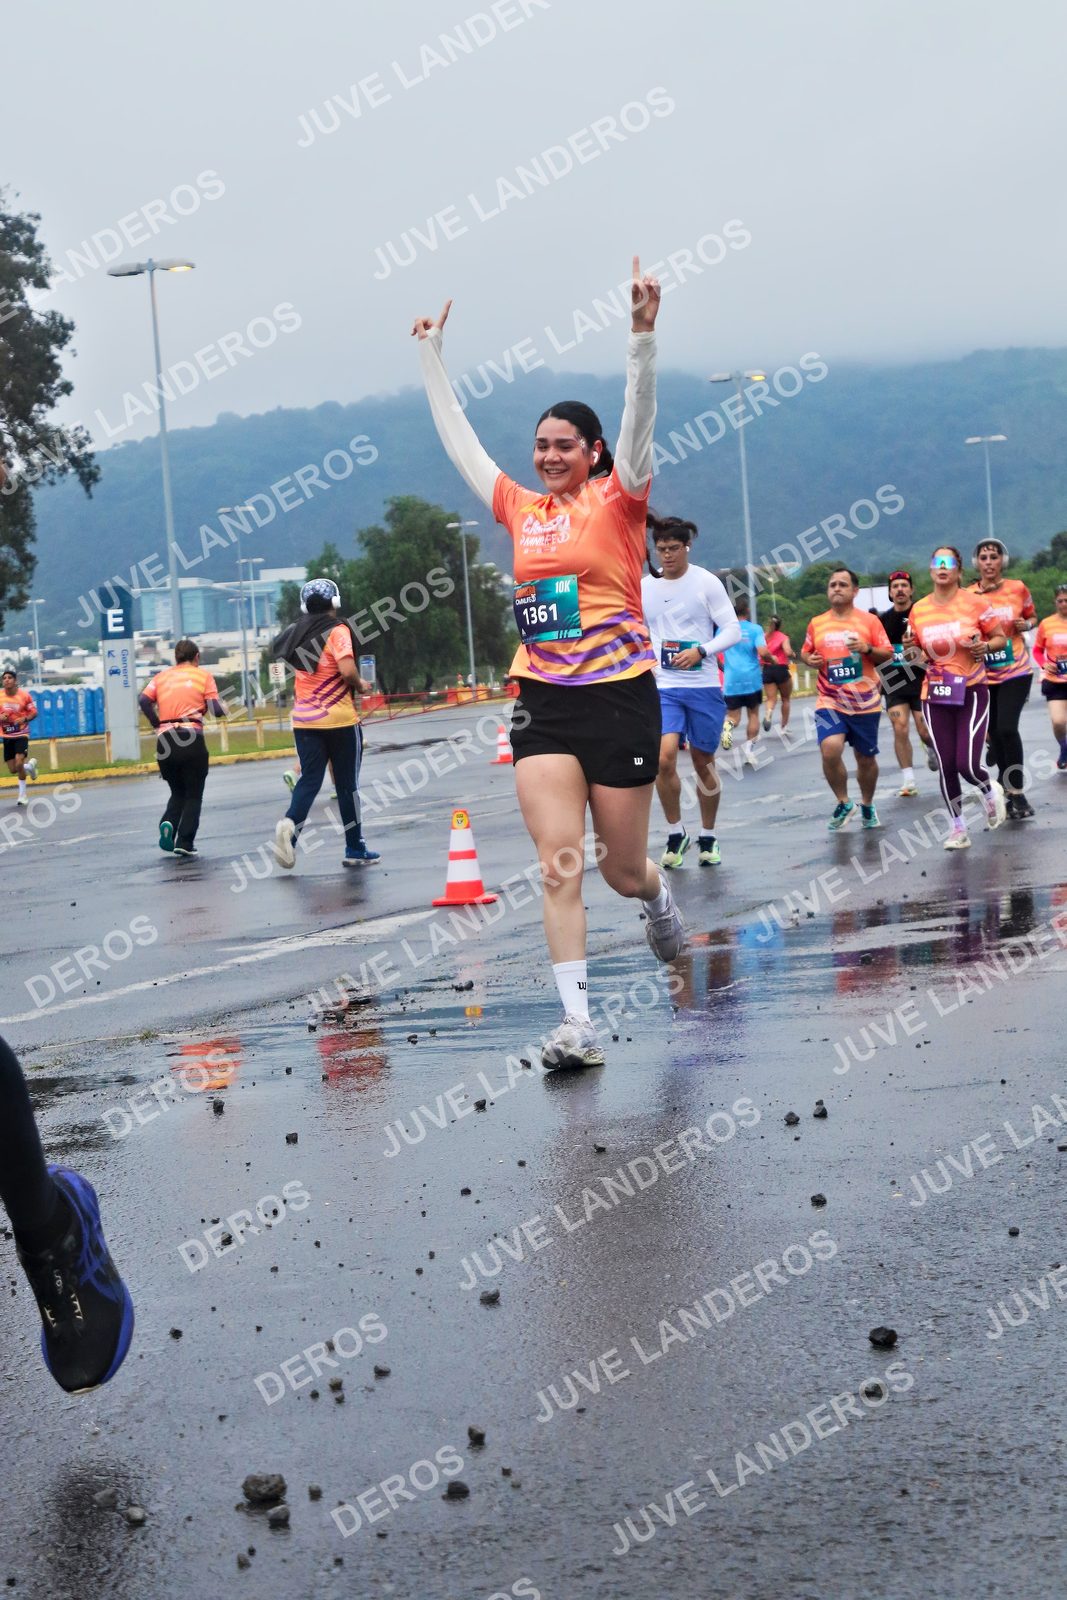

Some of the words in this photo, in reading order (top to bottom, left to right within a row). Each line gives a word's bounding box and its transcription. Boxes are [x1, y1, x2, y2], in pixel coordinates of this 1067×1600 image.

[555, 580, 571, 593] 10K
[107, 608, 125, 633] E
[523, 603, 558, 625] 1361
[984, 650, 1007, 661] 1156
[121, 649, 130, 688] General
[833, 667, 856, 677] 1331
[933, 686, 952, 696] 458
